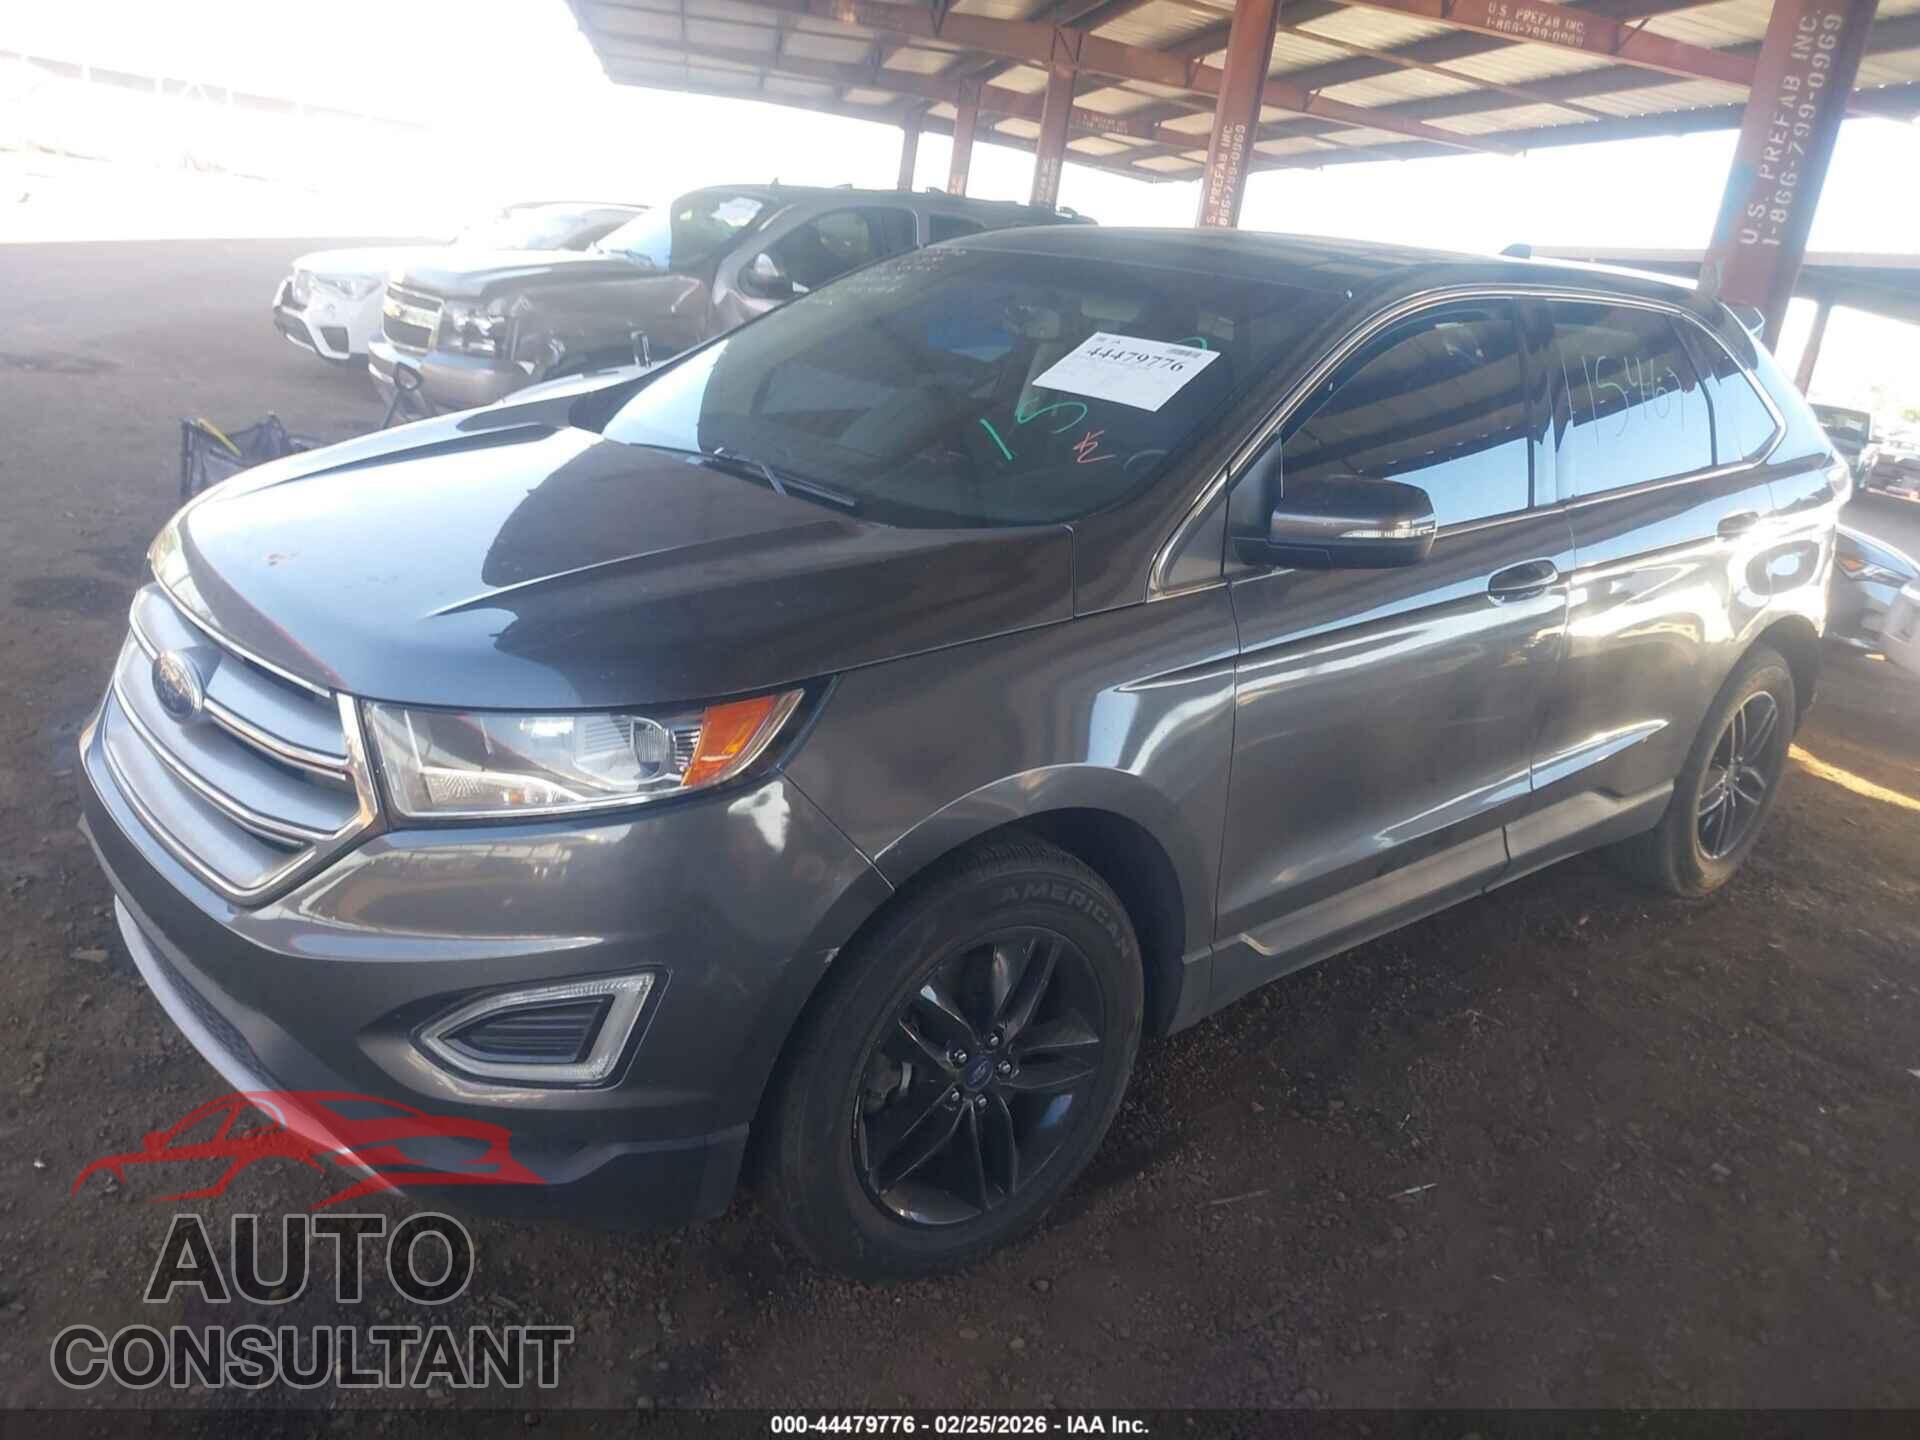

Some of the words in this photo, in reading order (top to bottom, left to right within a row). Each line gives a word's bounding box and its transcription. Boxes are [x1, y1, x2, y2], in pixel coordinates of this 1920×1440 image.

[1740, 198, 1768, 245] U.S.
[1759, 75, 1801, 180] PREFAB
[1791, 9, 1822, 60] INC.
[1762, 13, 1842, 246] 1-866-799-0969
